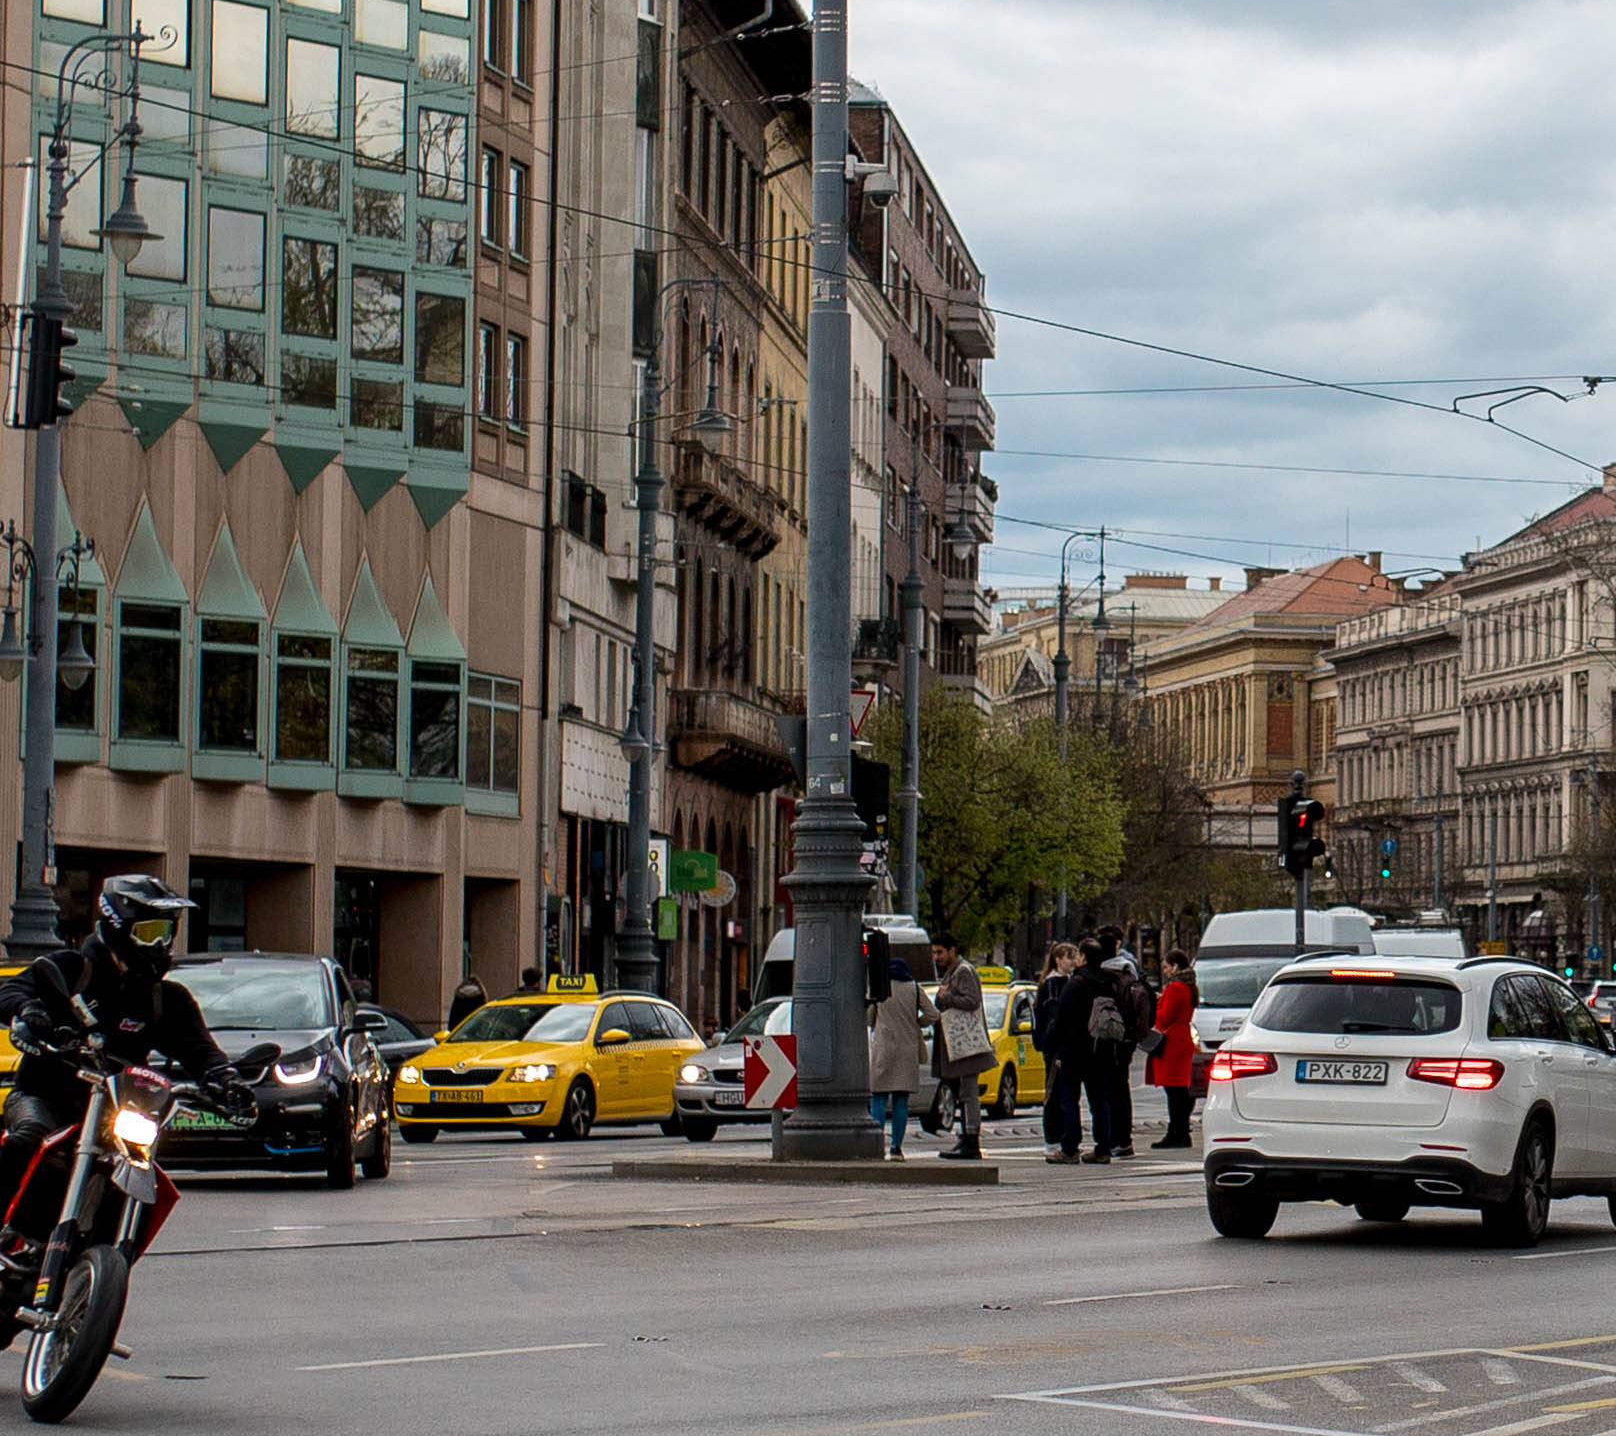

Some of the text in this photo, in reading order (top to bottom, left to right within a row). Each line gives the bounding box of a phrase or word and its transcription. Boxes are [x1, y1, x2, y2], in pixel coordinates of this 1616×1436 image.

[809, 777, 821, 789] 64
[560, 977, 583, 987] TAXI
[1309, 1062, 1383, 1080] PXK-822
